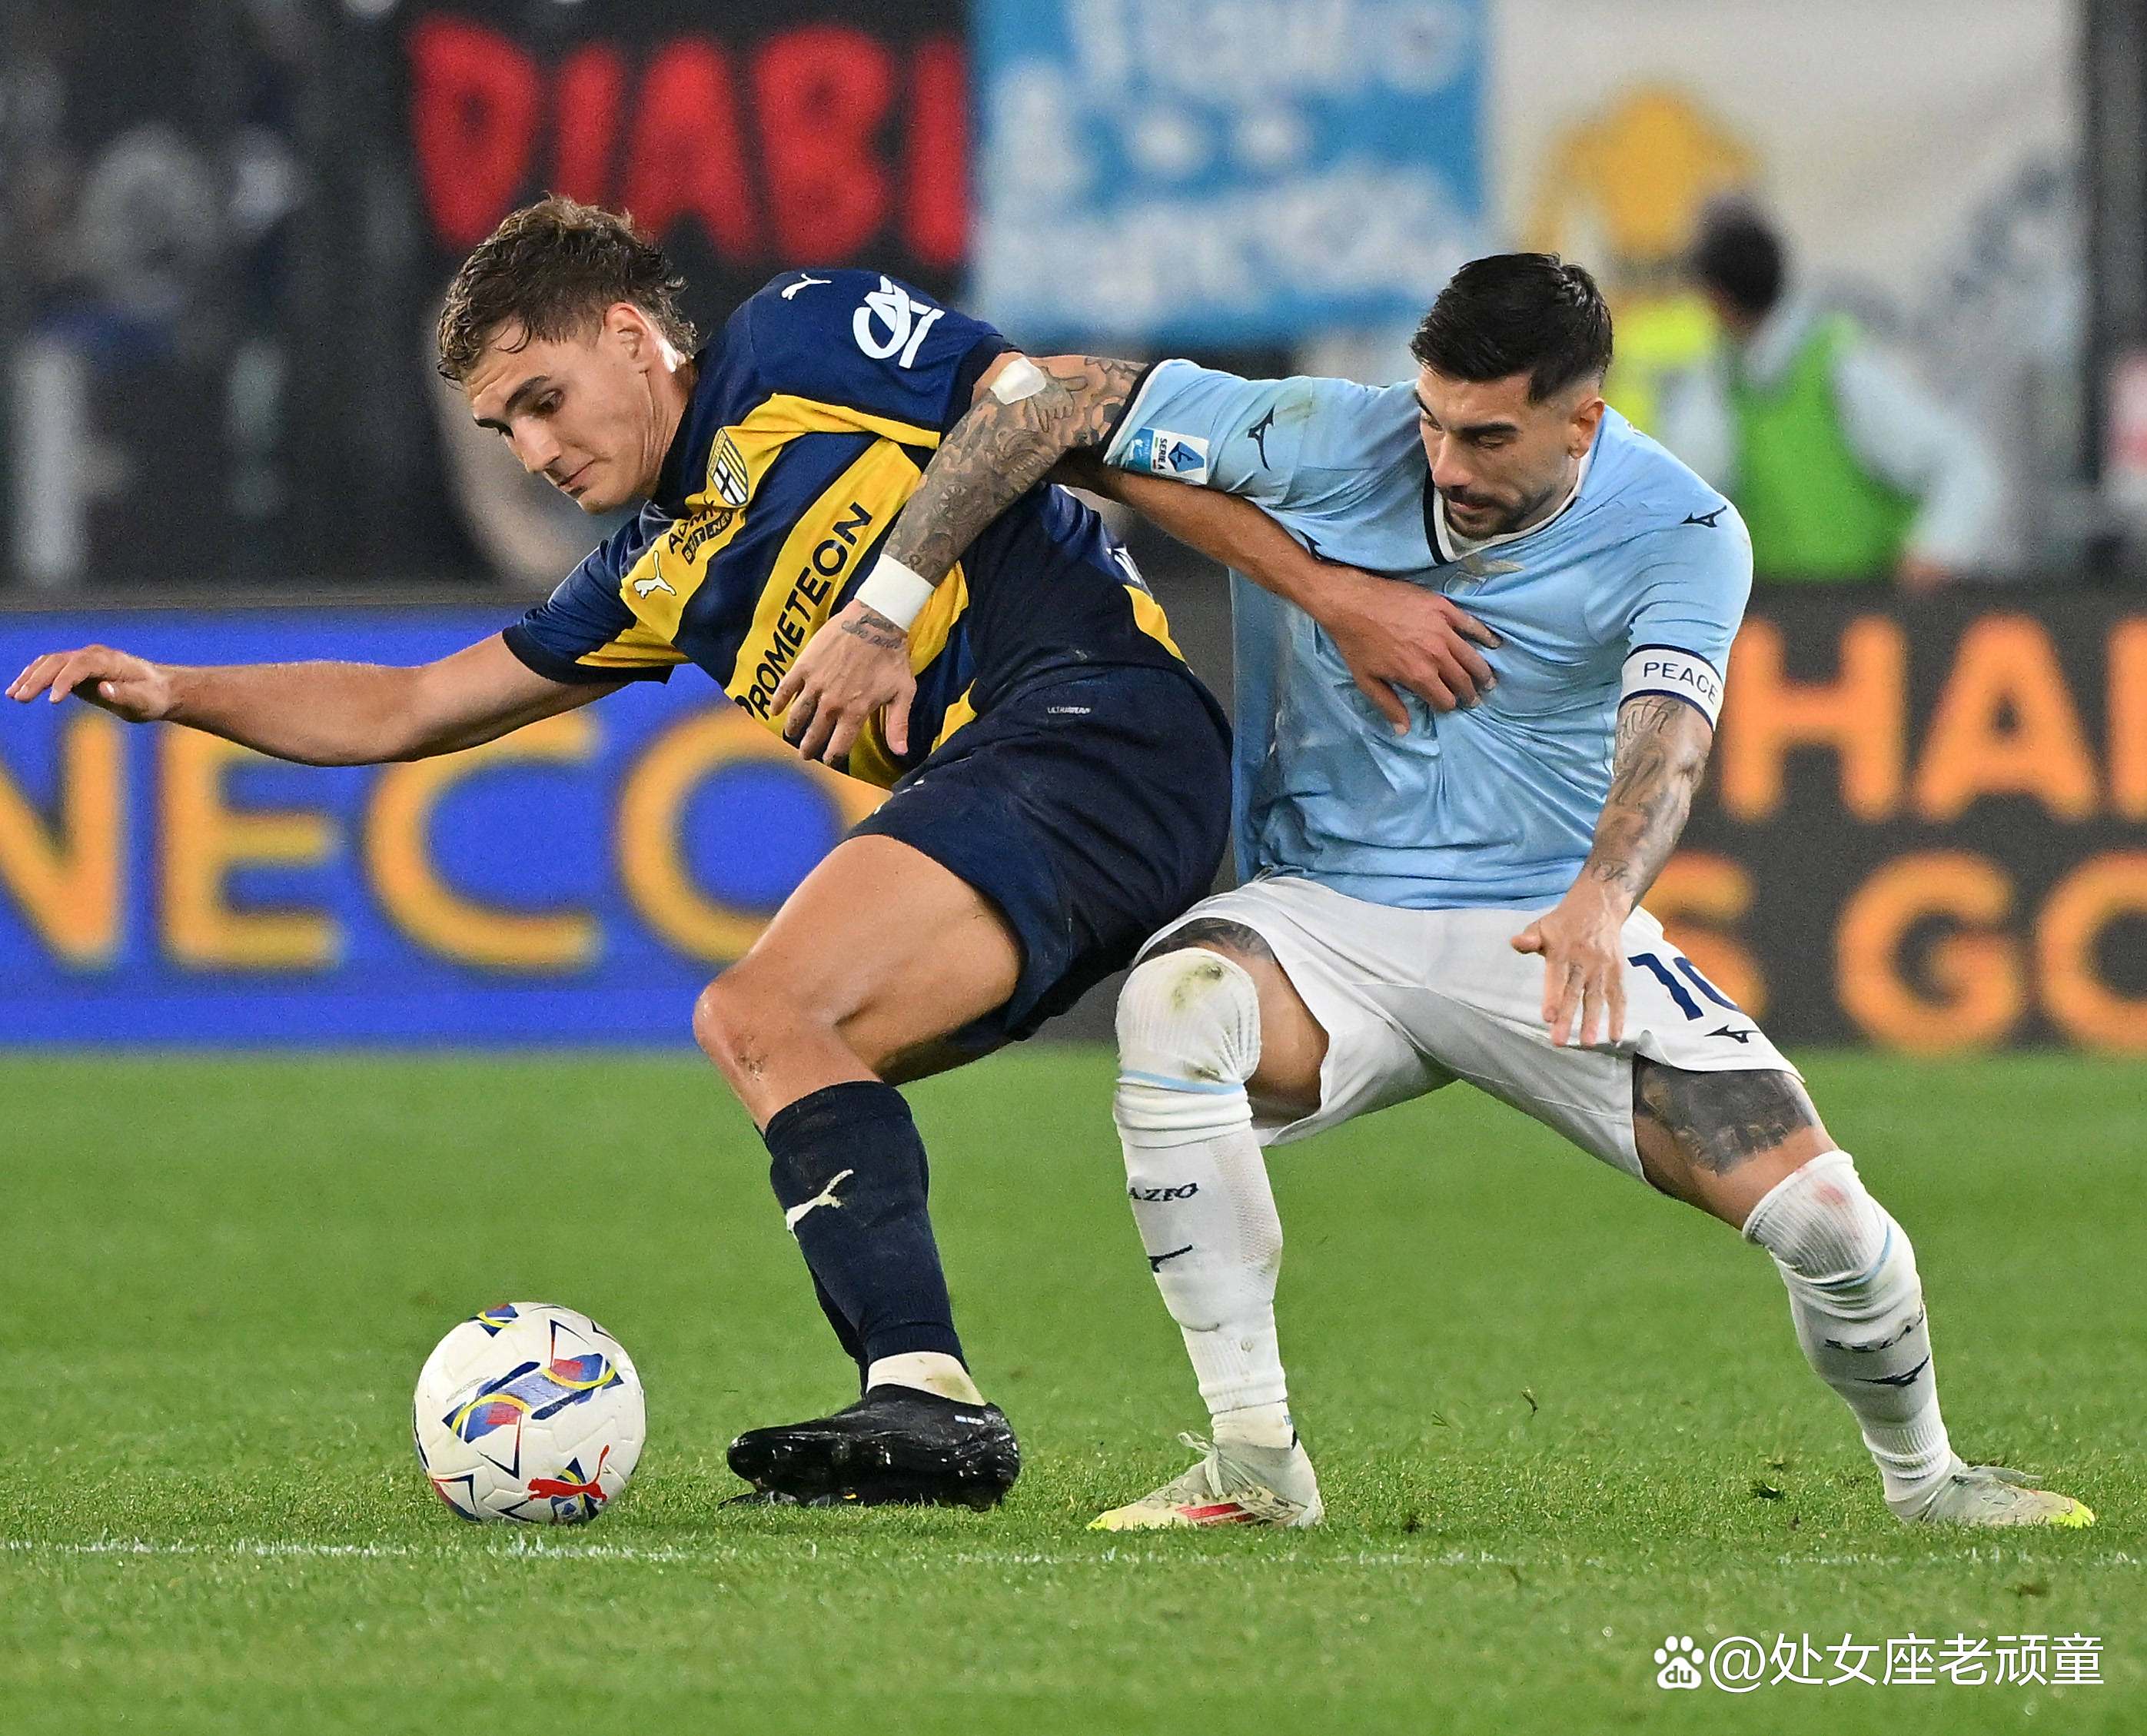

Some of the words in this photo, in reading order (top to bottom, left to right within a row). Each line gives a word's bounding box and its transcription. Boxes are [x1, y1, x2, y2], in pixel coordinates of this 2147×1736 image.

[1158, 437, 1168, 463] SERIE
[1643, 662, 1717, 705] PEACE
[1720, 615, 2147, 823] HA
